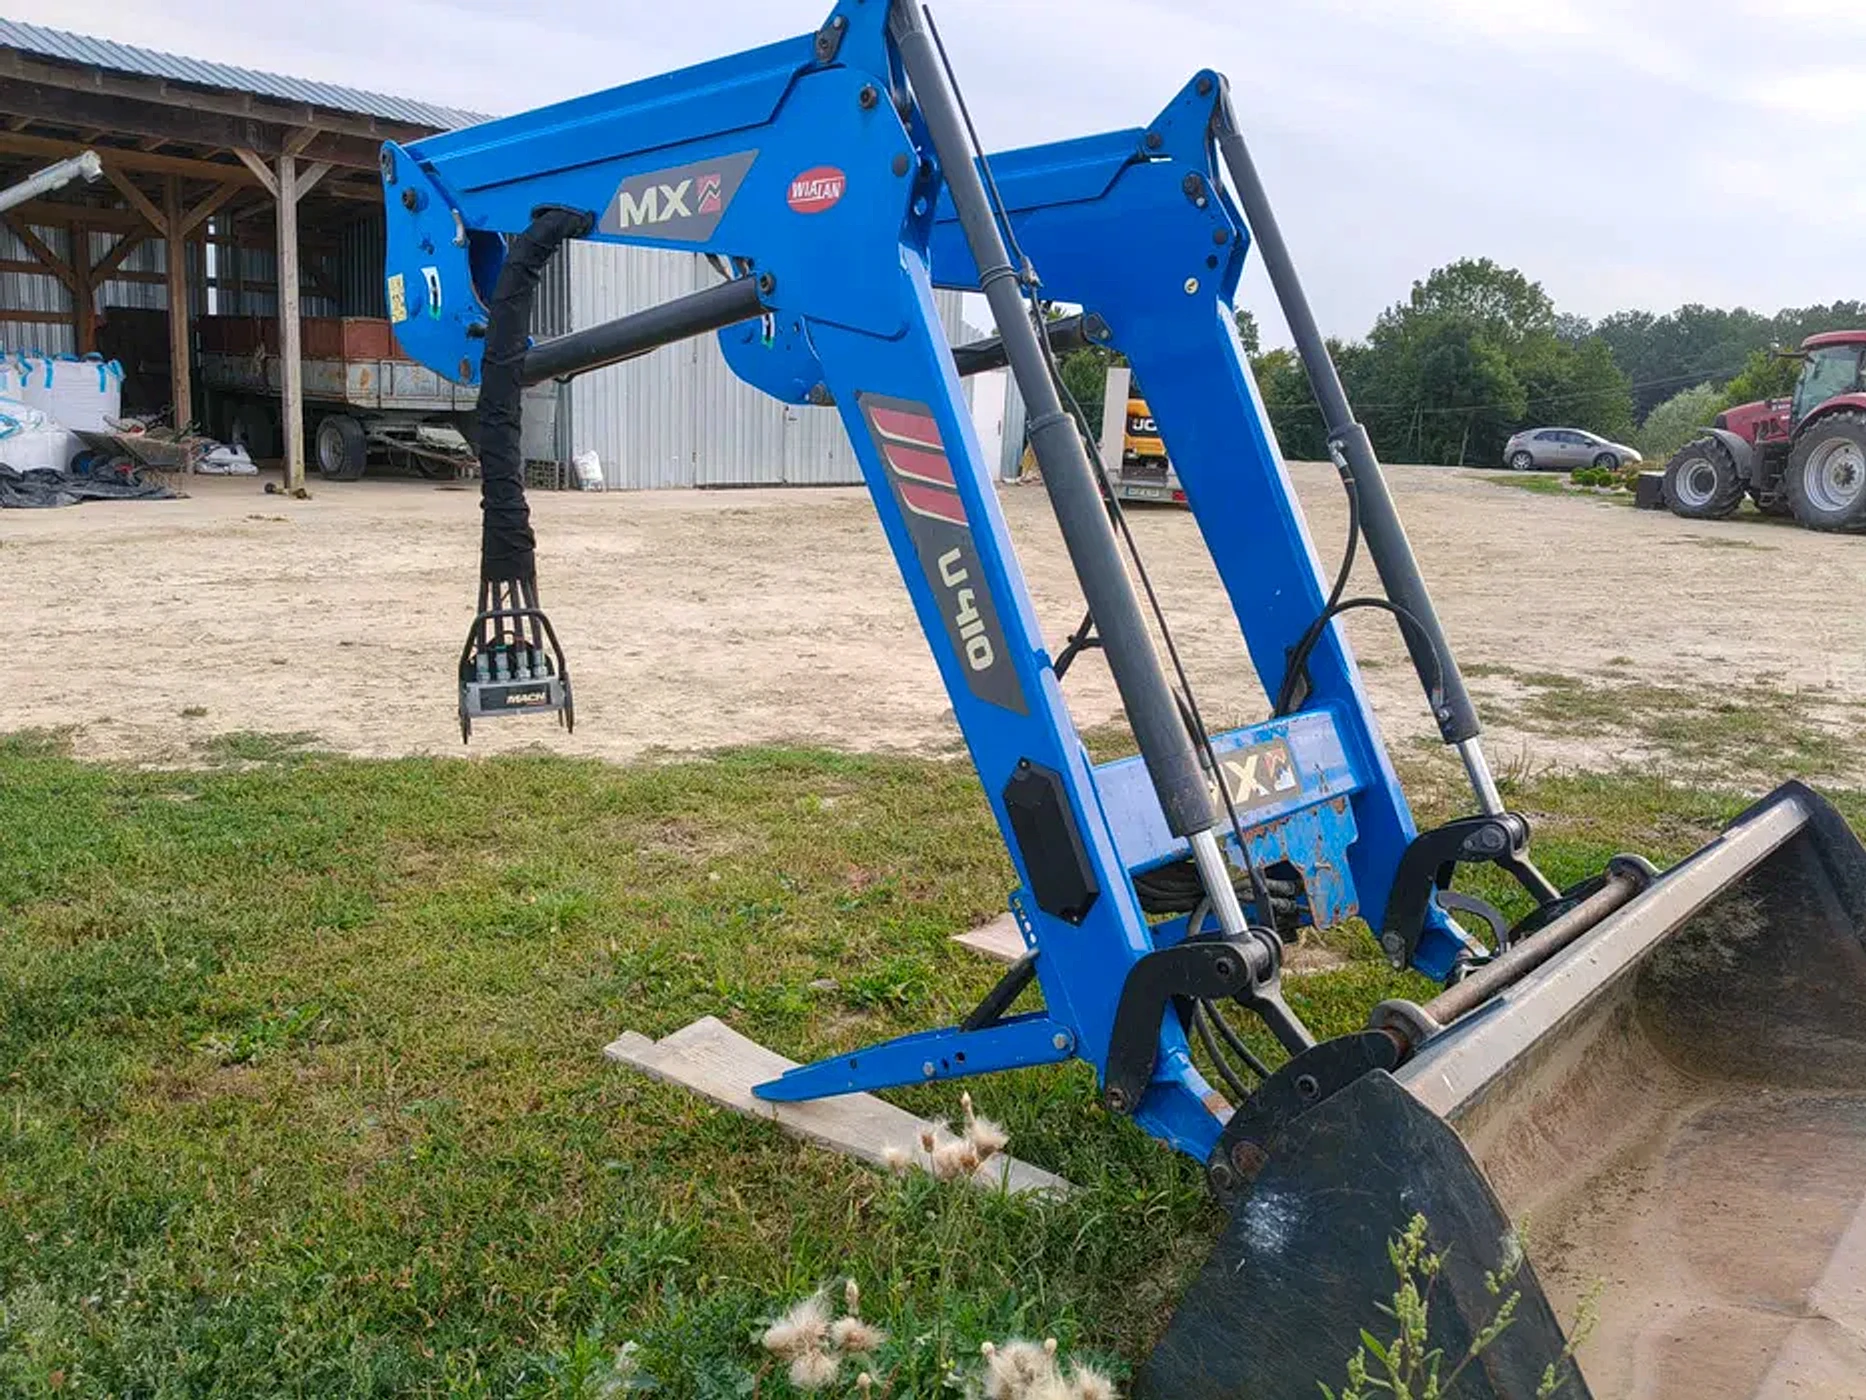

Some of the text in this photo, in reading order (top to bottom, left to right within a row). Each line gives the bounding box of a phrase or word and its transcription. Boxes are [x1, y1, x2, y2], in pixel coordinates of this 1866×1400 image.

[619, 178, 693, 229] MX
[1132, 418, 1158, 432] JC
[937, 547, 995, 672] U 410
